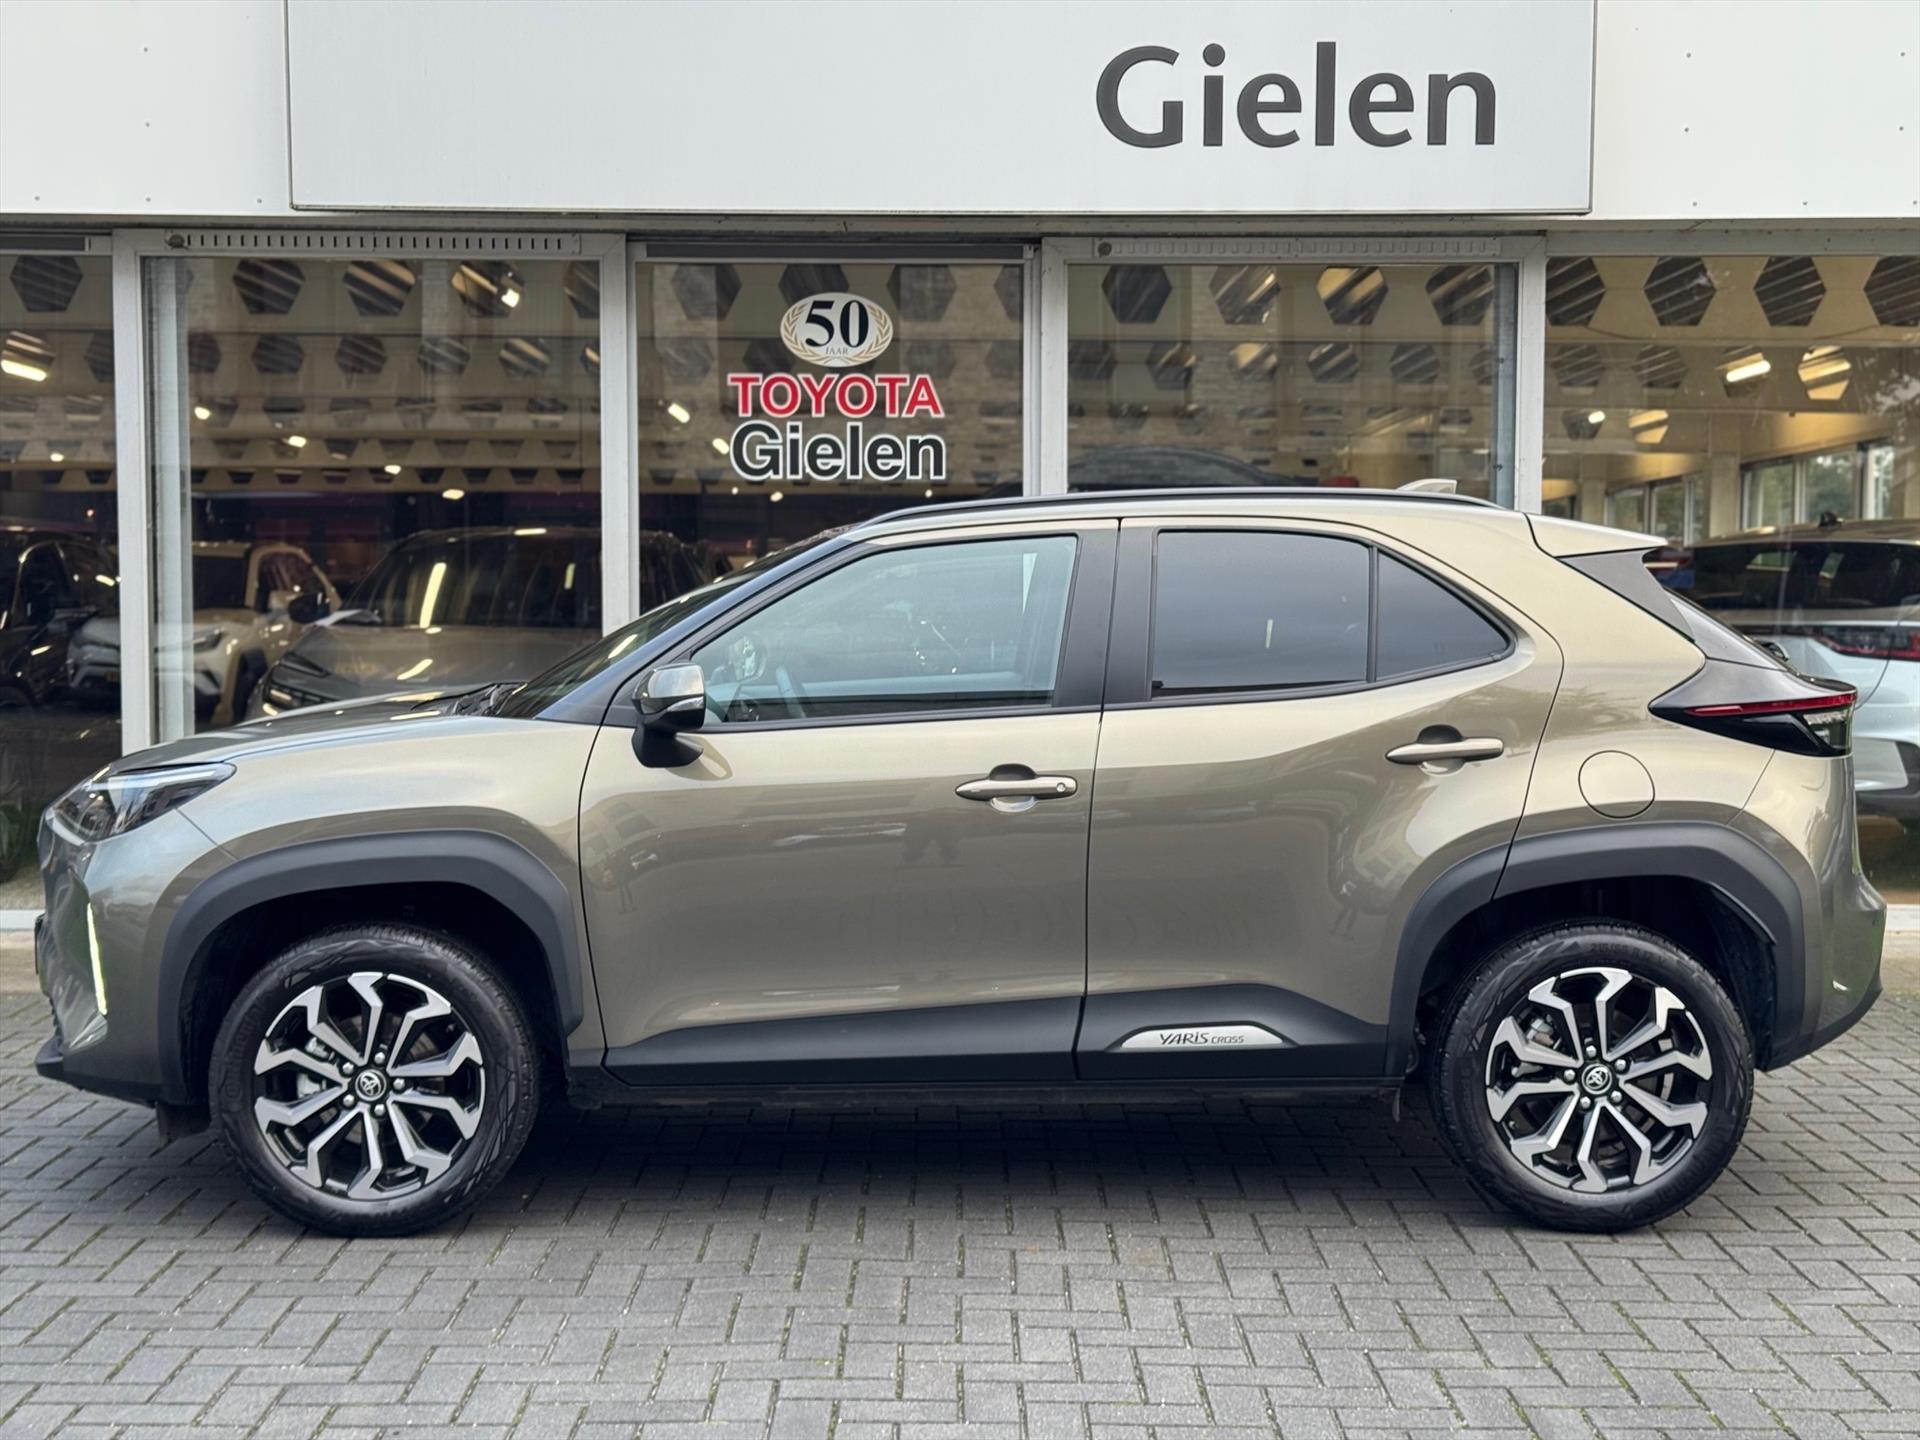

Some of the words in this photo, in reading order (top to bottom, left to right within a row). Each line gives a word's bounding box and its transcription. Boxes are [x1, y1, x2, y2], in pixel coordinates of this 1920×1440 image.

[1096, 42, 1496, 148] Gielen
[805, 300, 869, 347] 50
[728, 373, 945, 417] TOYOTA
[730, 420, 946, 480] Gielen
